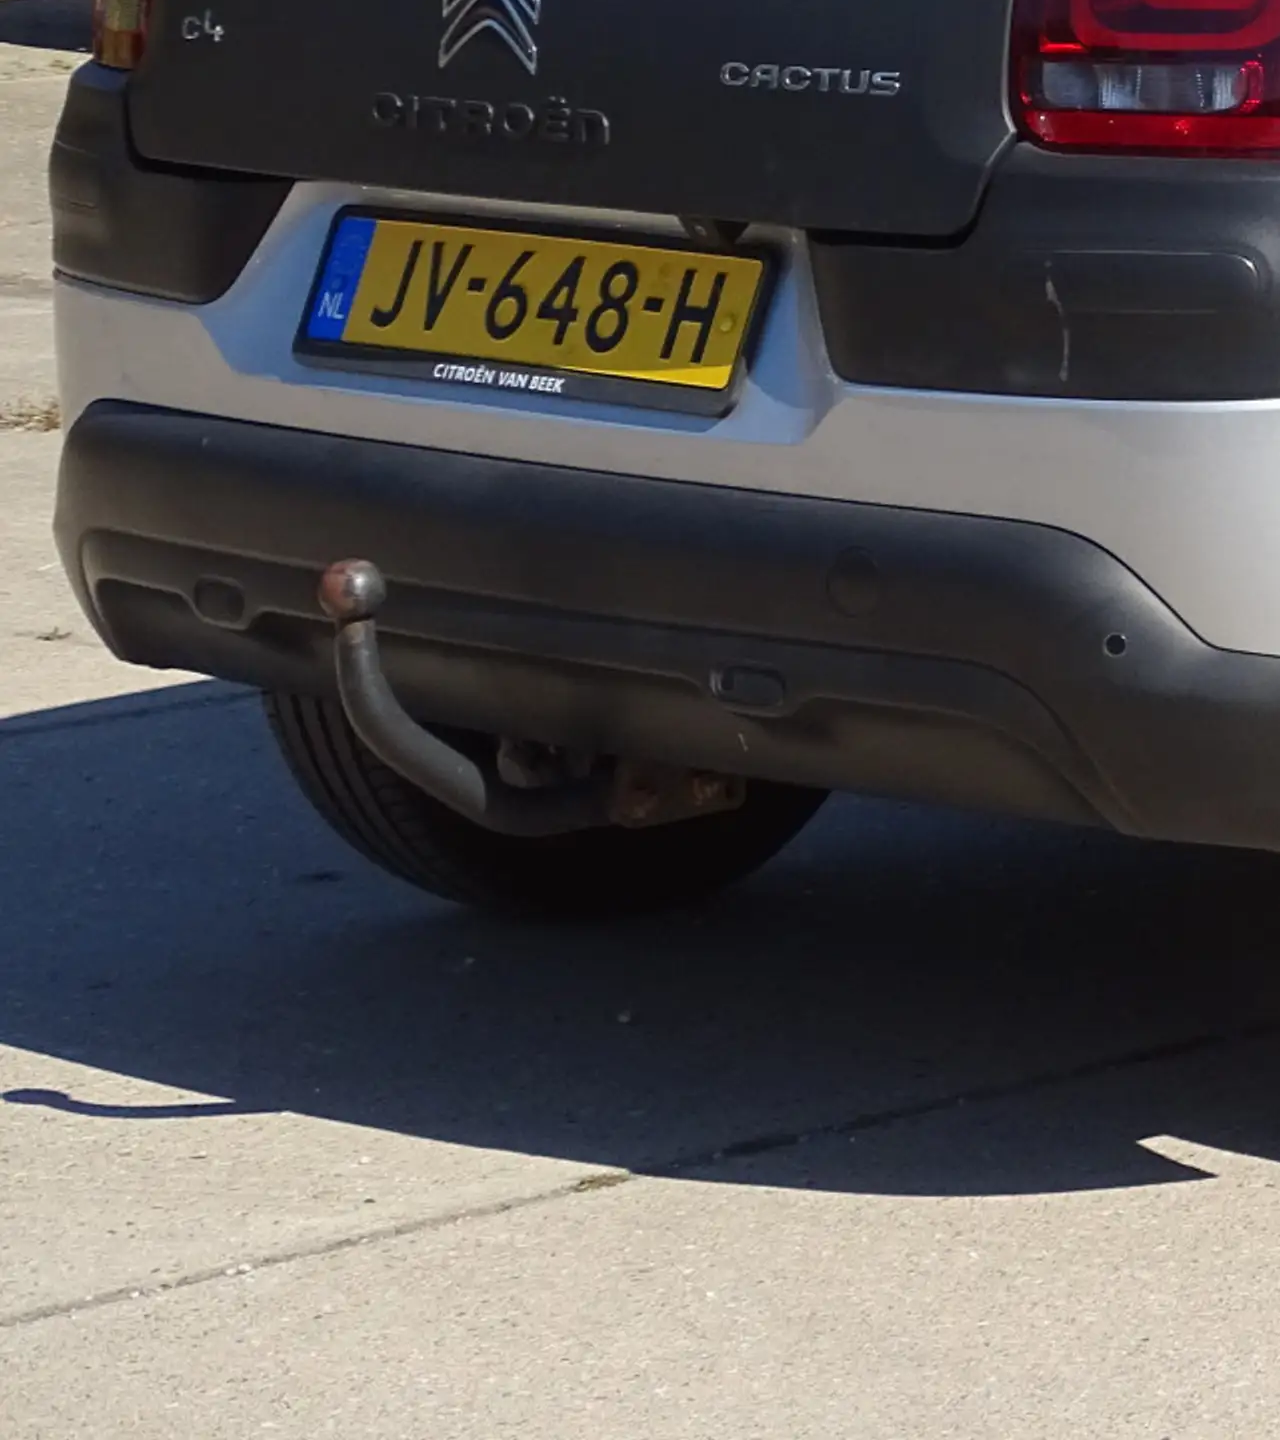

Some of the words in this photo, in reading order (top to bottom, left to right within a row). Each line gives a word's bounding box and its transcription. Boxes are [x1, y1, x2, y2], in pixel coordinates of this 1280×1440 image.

[182, 8, 225, 43] C4
[719, 61, 901, 96] CACTUS
[317, 291, 345, 320] NL
[370, 239, 728, 364] JV-648-H
[433, 362, 497, 385] CITROËN
[498, 371, 530, 389] VAN
[528, 375, 566, 393] BEEK
